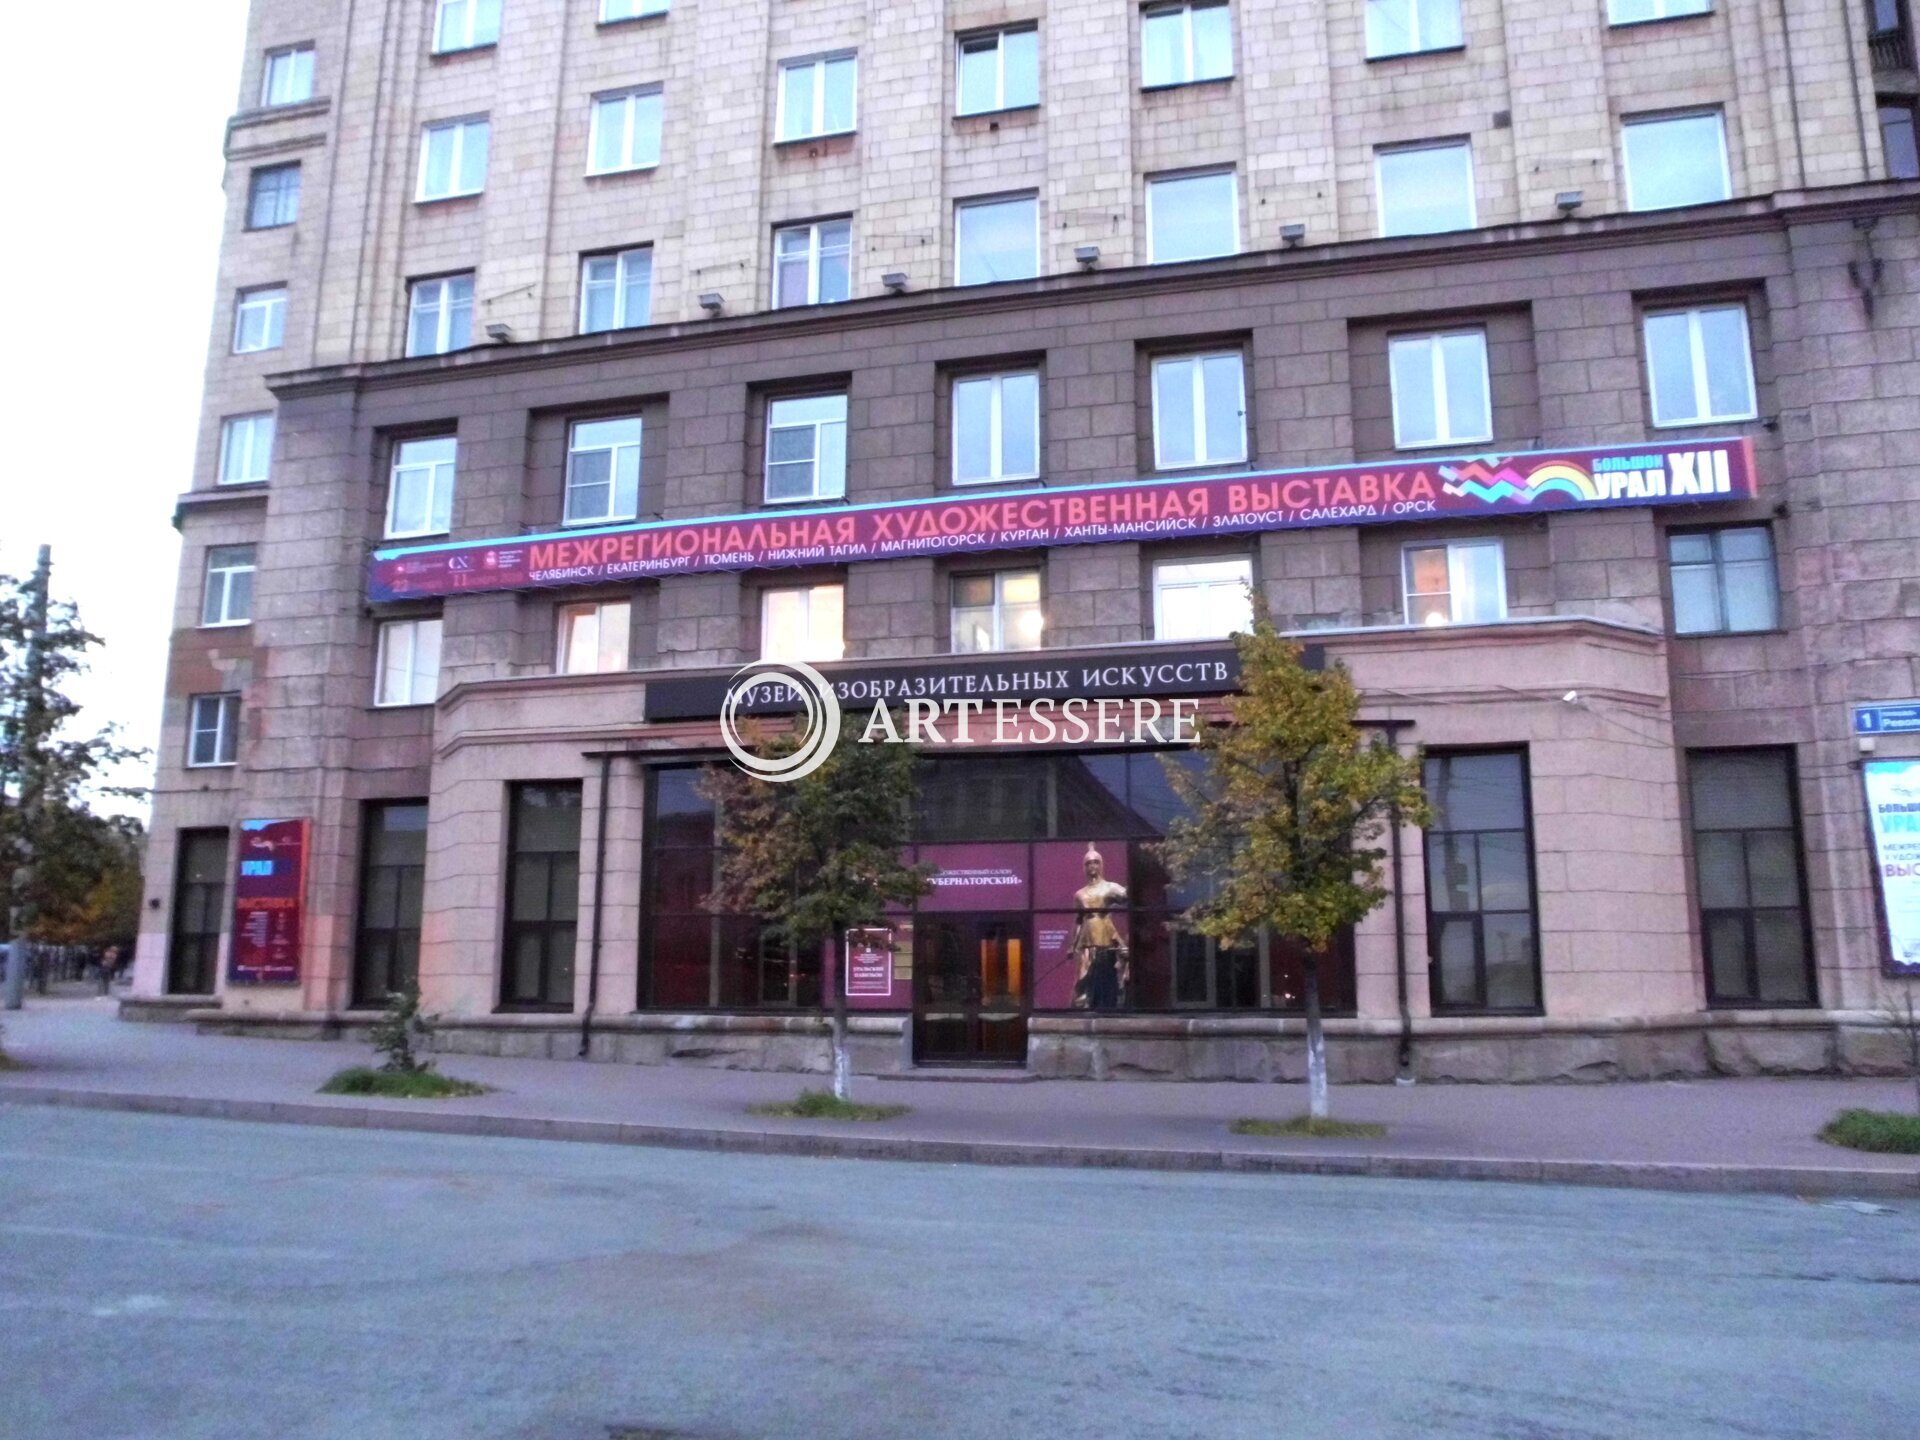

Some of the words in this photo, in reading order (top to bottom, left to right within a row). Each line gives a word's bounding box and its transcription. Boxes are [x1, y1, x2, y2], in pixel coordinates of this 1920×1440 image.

[1593, 469, 1667, 500] УРАЛ
[528, 565, 595, 581] ЧЕЛЯБИНСК
[607, 555, 691, 575] ЕКАТЕРИНБУРГ
[704, 551, 754, 566] ТЮМЕНЬ
[768, 543, 825, 561] НИЖНИЙ
[829, 543, 868, 558] ТАГИЛ
[881, 532, 986, 553] МАГНИТОГОРСК
[1000, 527, 1050, 543] КУРГАН
[1064, 516, 1196, 539] ХАНТЫ-МАНСИЙСК
[1212, 511, 1284, 528] ЗЛАТОУСТ
[1300, 505, 1377, 521] САЛЕХАРД
[1393, 500, 1436, 515] ОРСК
[529, 516, 855, 572] МЕЖРЕГИОНАЛЬНАЯ
[873, 487, 1209, 541] ХУДОЖЕСТВЕННАЯ
[1228, 471, 1436, 513] ВЫСТАВКА
[818, 669, 1069, 701] ИЗОБРАЗИТЕЛЬНЫХ
[1082, 662, 1228, 688] ИСКУССТВ
